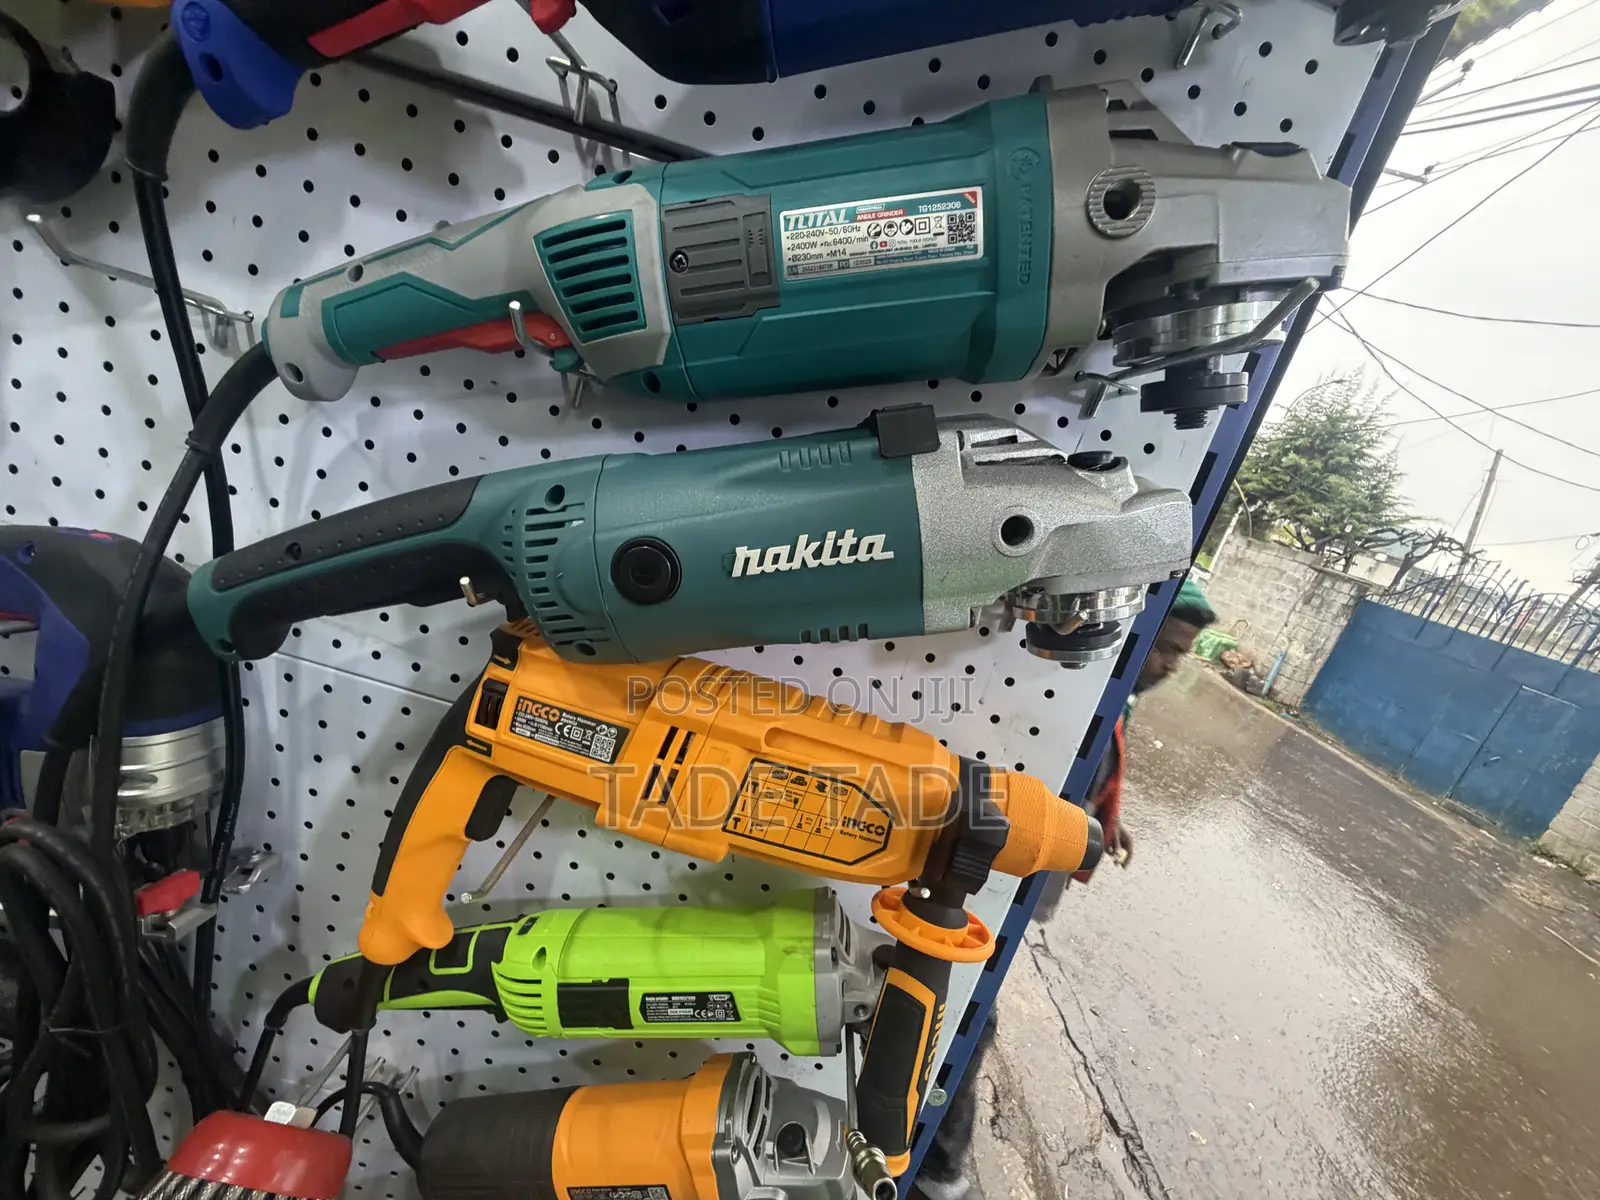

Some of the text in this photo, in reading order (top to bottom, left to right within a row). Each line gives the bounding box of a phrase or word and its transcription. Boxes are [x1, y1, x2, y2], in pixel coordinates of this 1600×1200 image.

[856, 208, 904, 221] ANGLE GRINDER
[917, 200, 962, 213] TG1252306
[786, 208, 850, 231] TOTAL
[1018, 183, 1032, 286] PATENTED
[839, 829, 883, 845] Rotary Hammer
